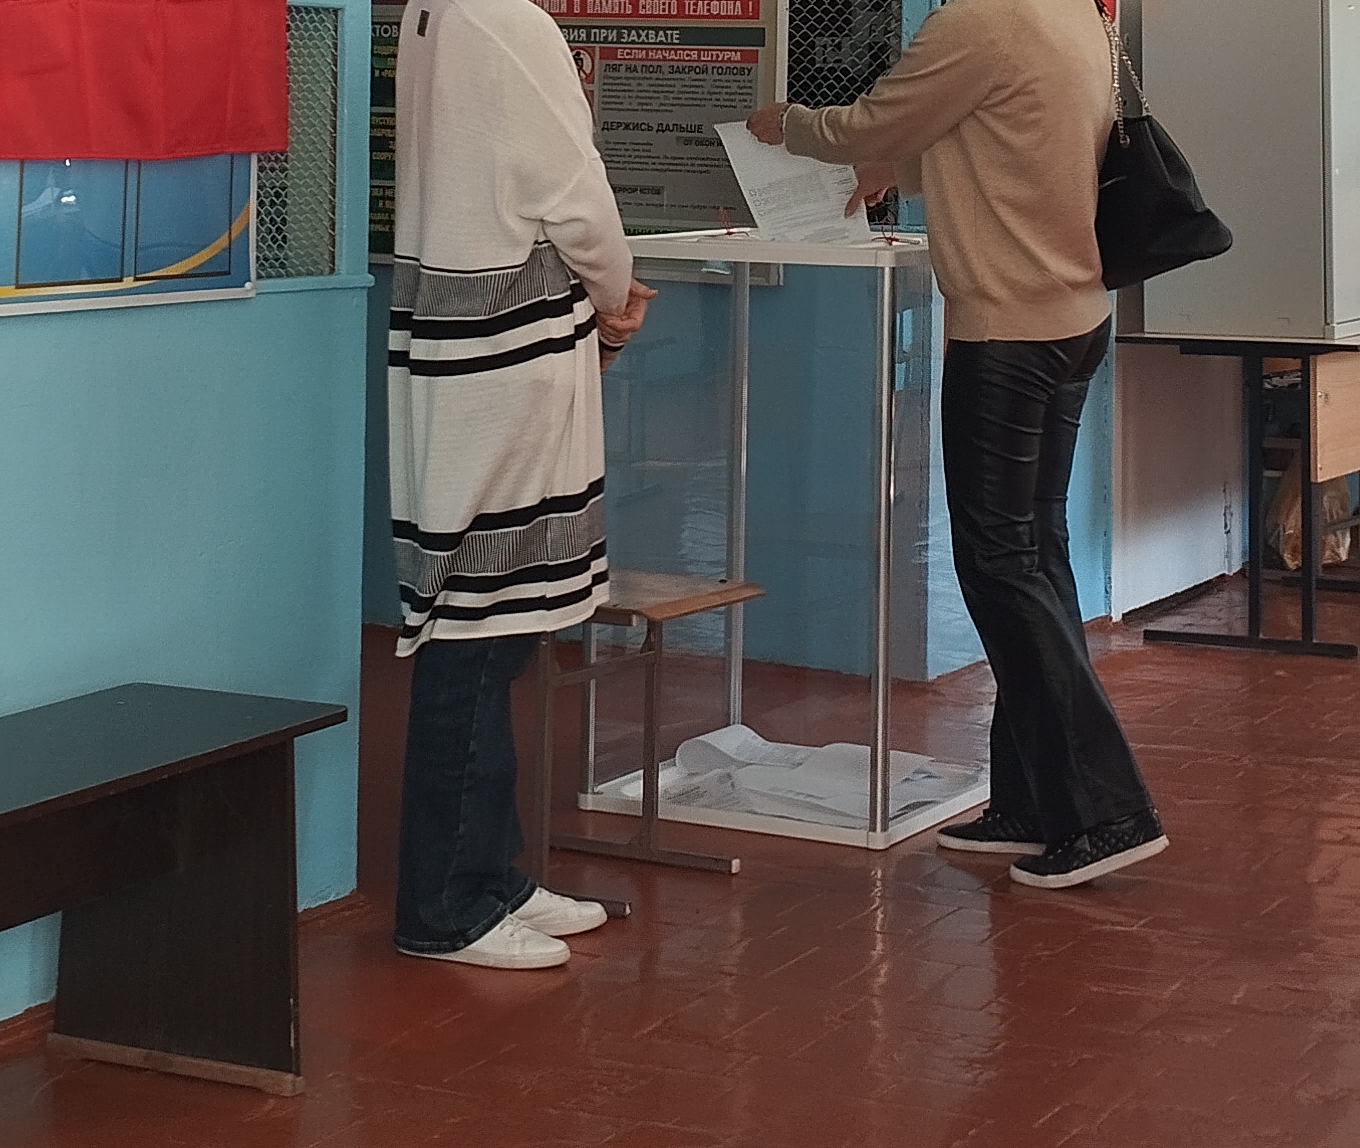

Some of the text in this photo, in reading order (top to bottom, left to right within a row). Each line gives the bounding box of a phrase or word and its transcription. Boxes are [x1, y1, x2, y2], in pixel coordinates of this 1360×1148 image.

[586, 0, 633, 15] ПАМЯТЬ
[638, 0, 678, 15] СВОЕГО
[684, 1, 742, 16] ТЕЛЕФОНА
[591, 29, 617, 42] ПРИ
[620, 29, 681, 43] ЗАХВАТЕ
[617, 49, 741, 62] ЕСЛИ НАЧАЛСЯ ШТУРМ
[603, 64, 623, 73] ЛЯГ
[625, 64, 638, 73] НА
[668, 63, 708, 75] ЗАКРОЙ
[711, 66, 753, 77] ГОЛОВУ
[601, 121, 704, 135] ДЕРЖИСЬ ДАЛЬШЕ
[613, 187, 661, 196] ЕРРОРИСТОВ
